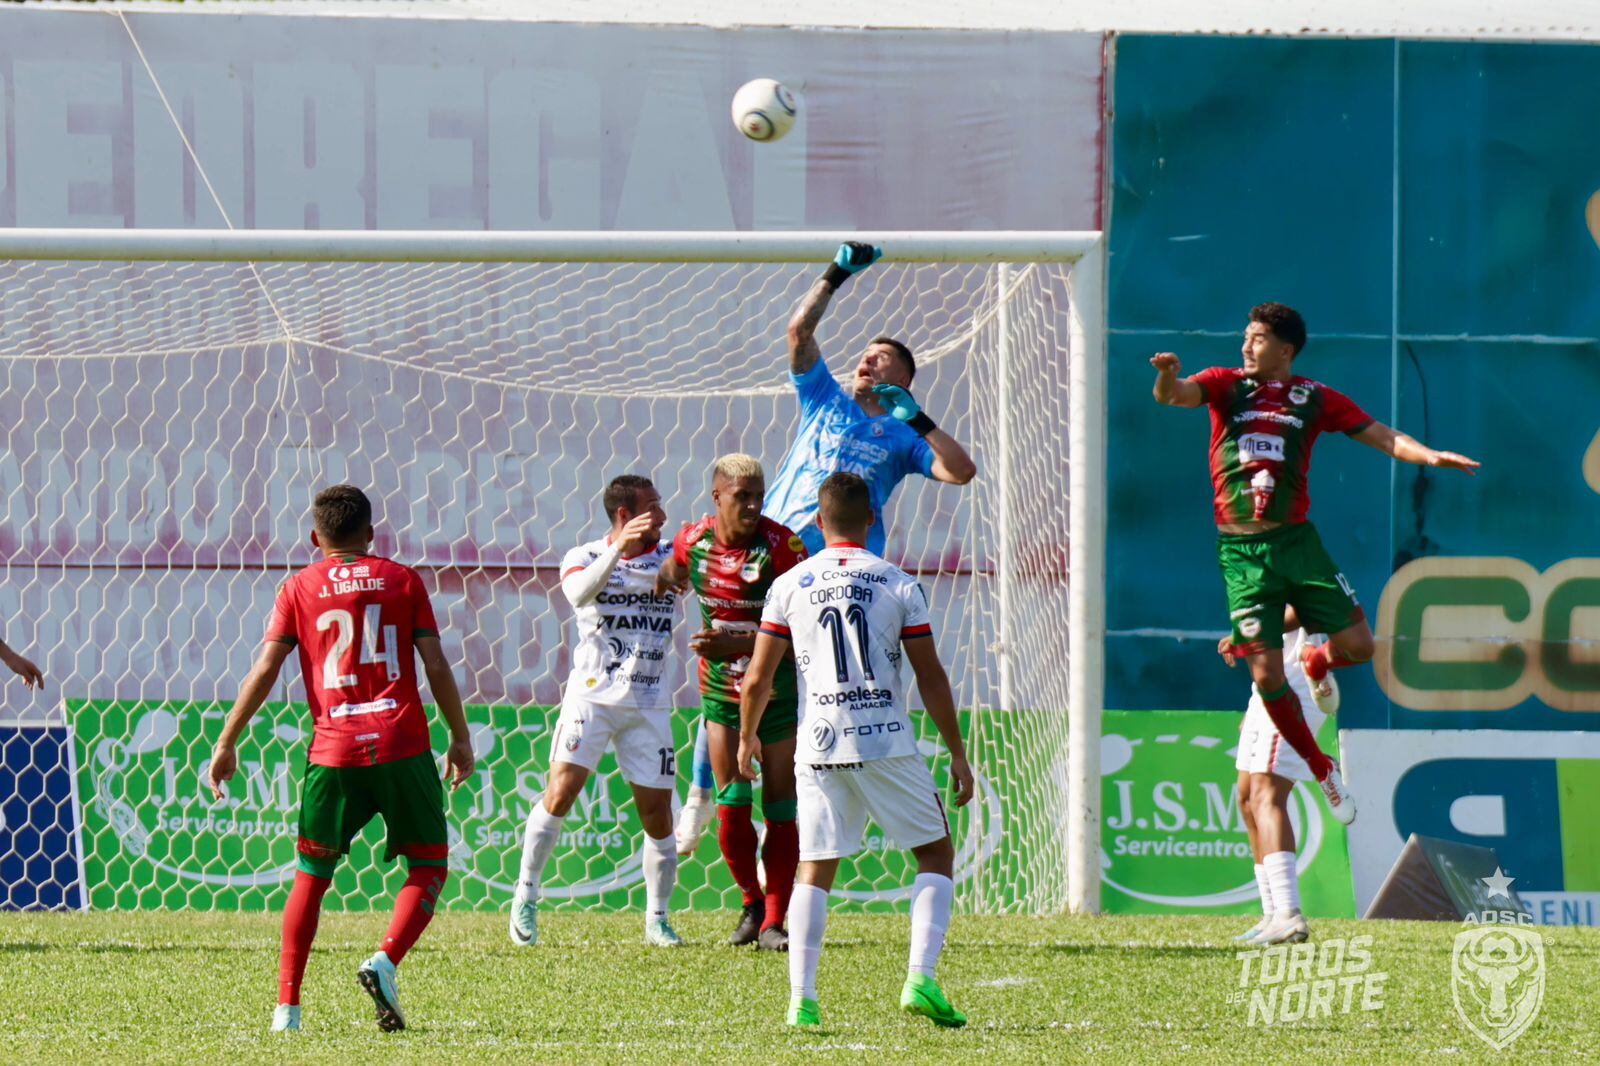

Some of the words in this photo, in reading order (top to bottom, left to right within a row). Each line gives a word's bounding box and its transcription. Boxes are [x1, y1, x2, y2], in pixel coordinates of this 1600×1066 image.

[0, 58, 857, 231] EDREGAL
[318, 585, 331, 598] J.
[333, 577, 385, 595] UGALDE
[821, 568, 888, 585] Coocique
[809, 584, 873, 605] CORDOBA
[316, 603, 400, 690] 24
[817, 603, 875, 684] 11
[658, 747, 675, 776] 12
[156, 812, 299, 836] Servicentros
